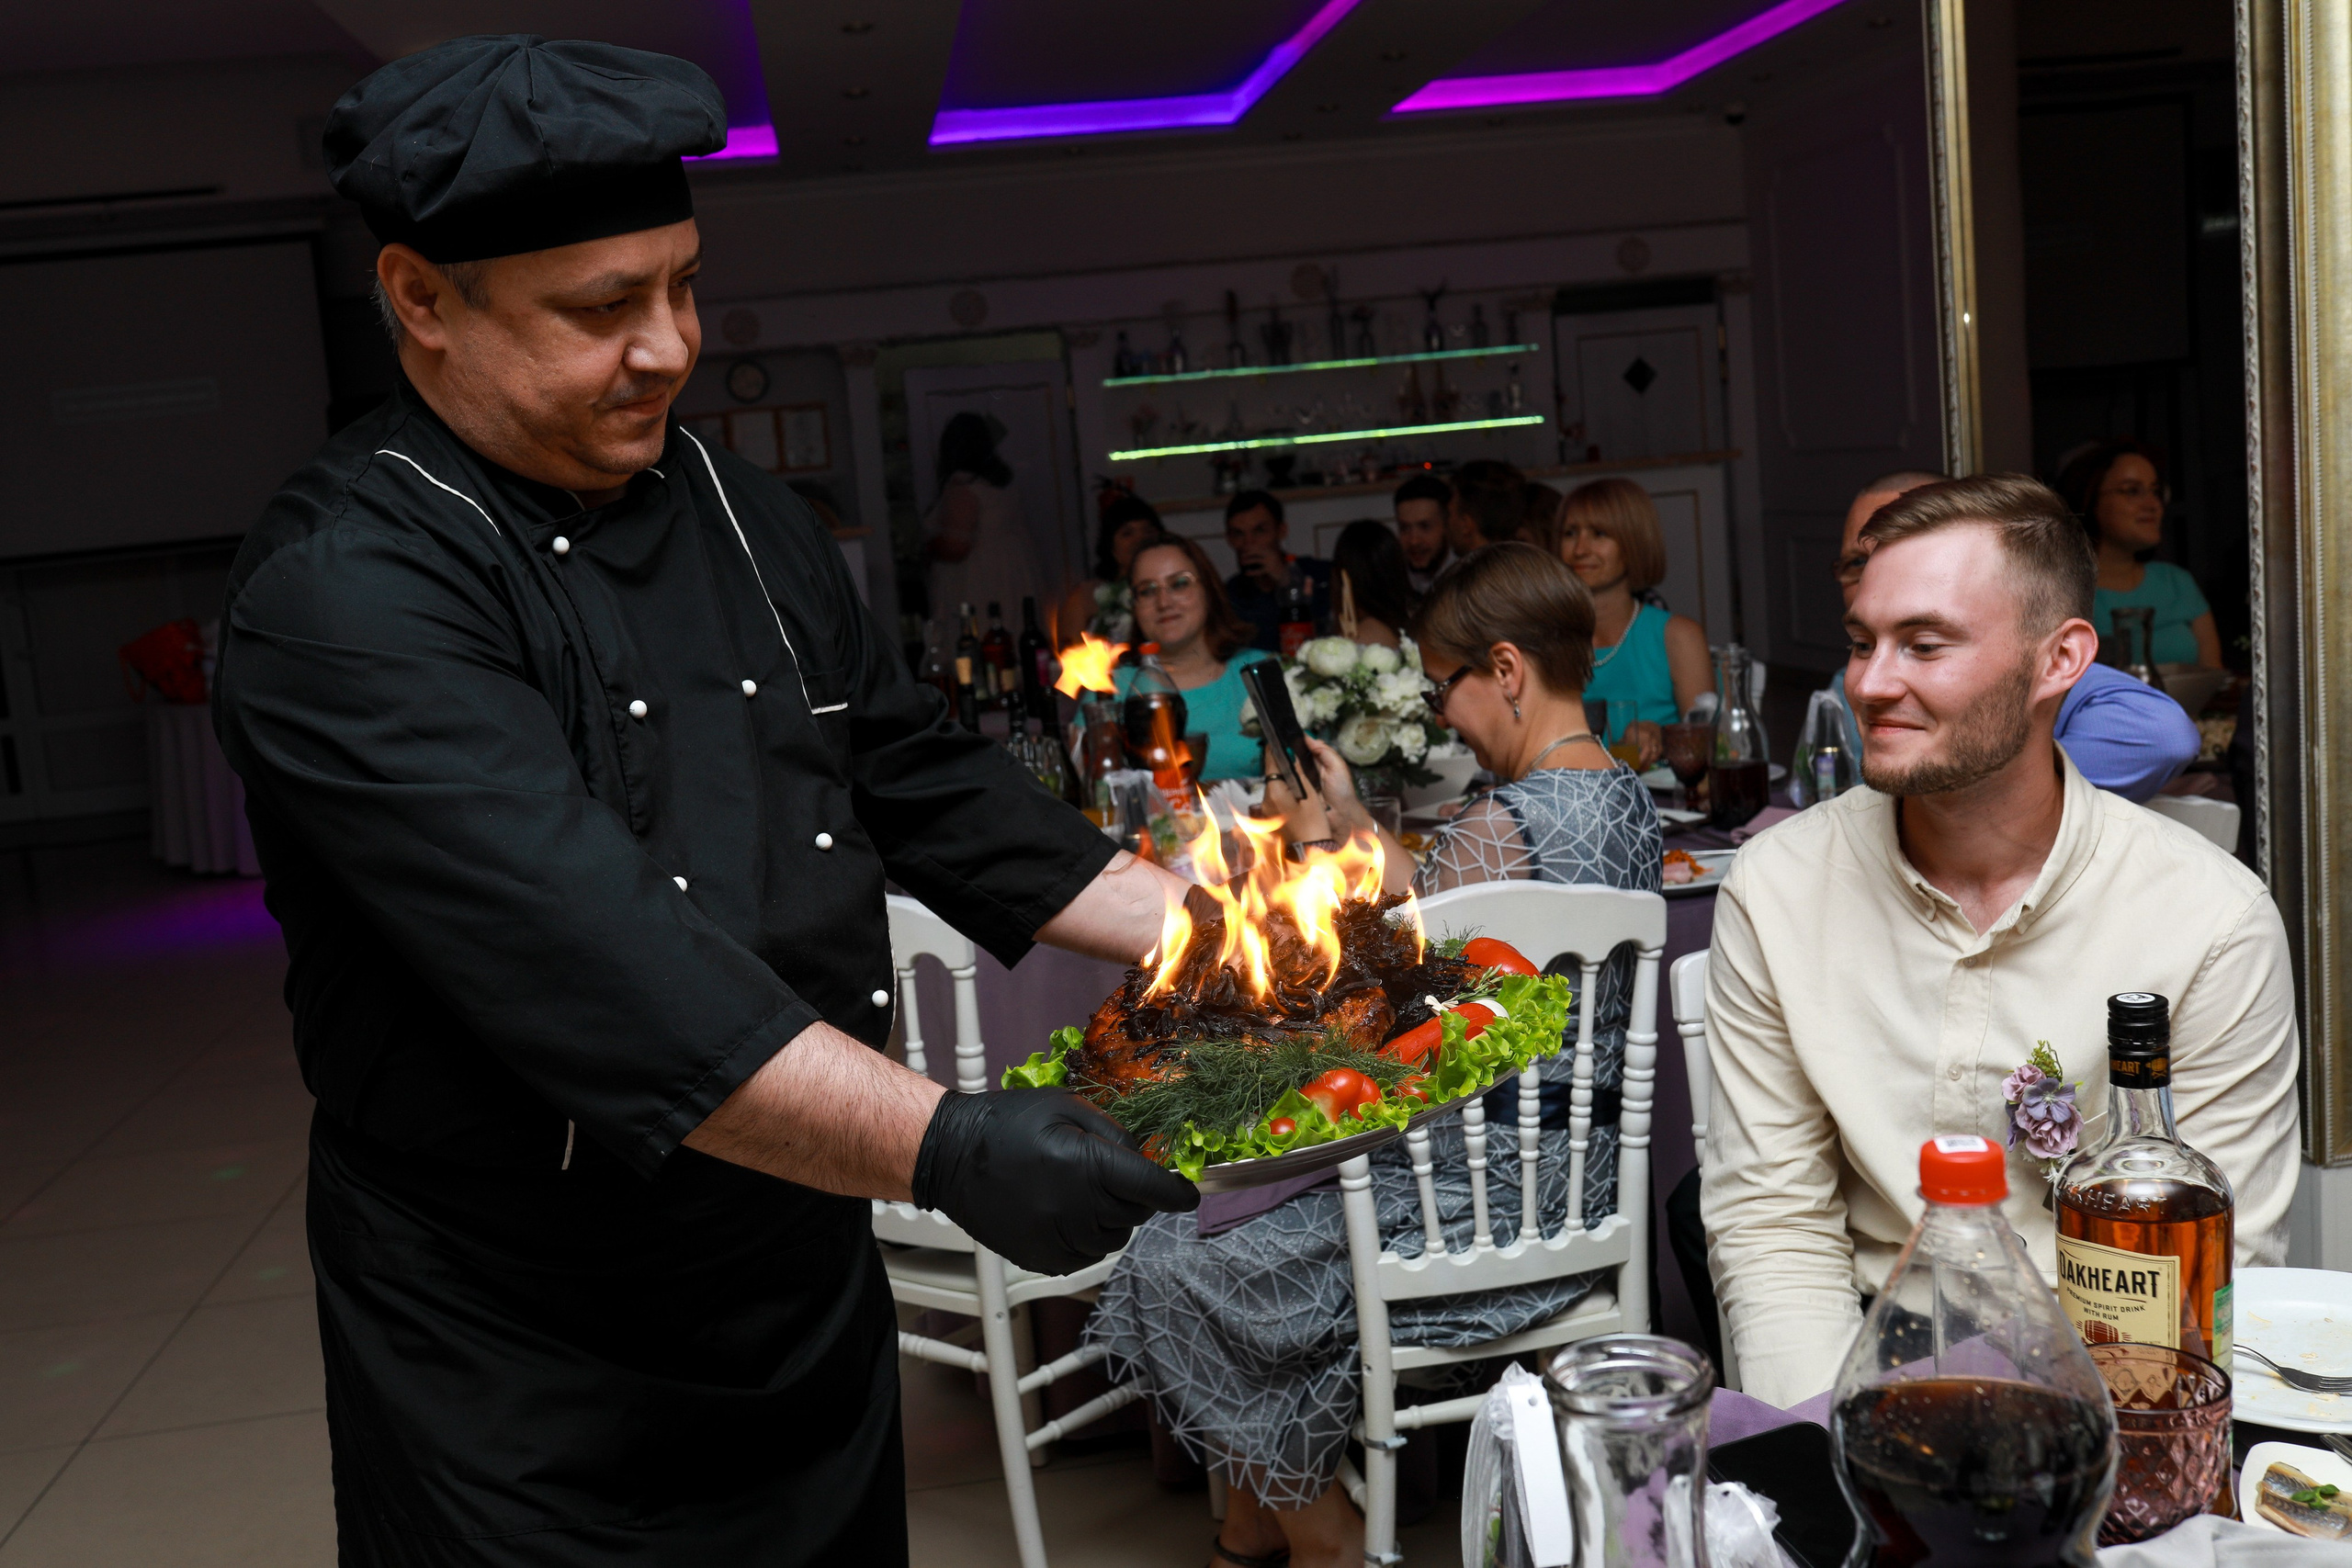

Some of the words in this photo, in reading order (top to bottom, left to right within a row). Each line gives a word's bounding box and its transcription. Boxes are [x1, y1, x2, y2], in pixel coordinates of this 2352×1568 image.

[2059, 1250, 2160, 1298] OAKHEART
[2066, 1287, 2092, 1306] PREMIUM
[2093, 1303, 2118, 1313] SPIRIT
[2083, 1307, 2100, 1317] WITH
